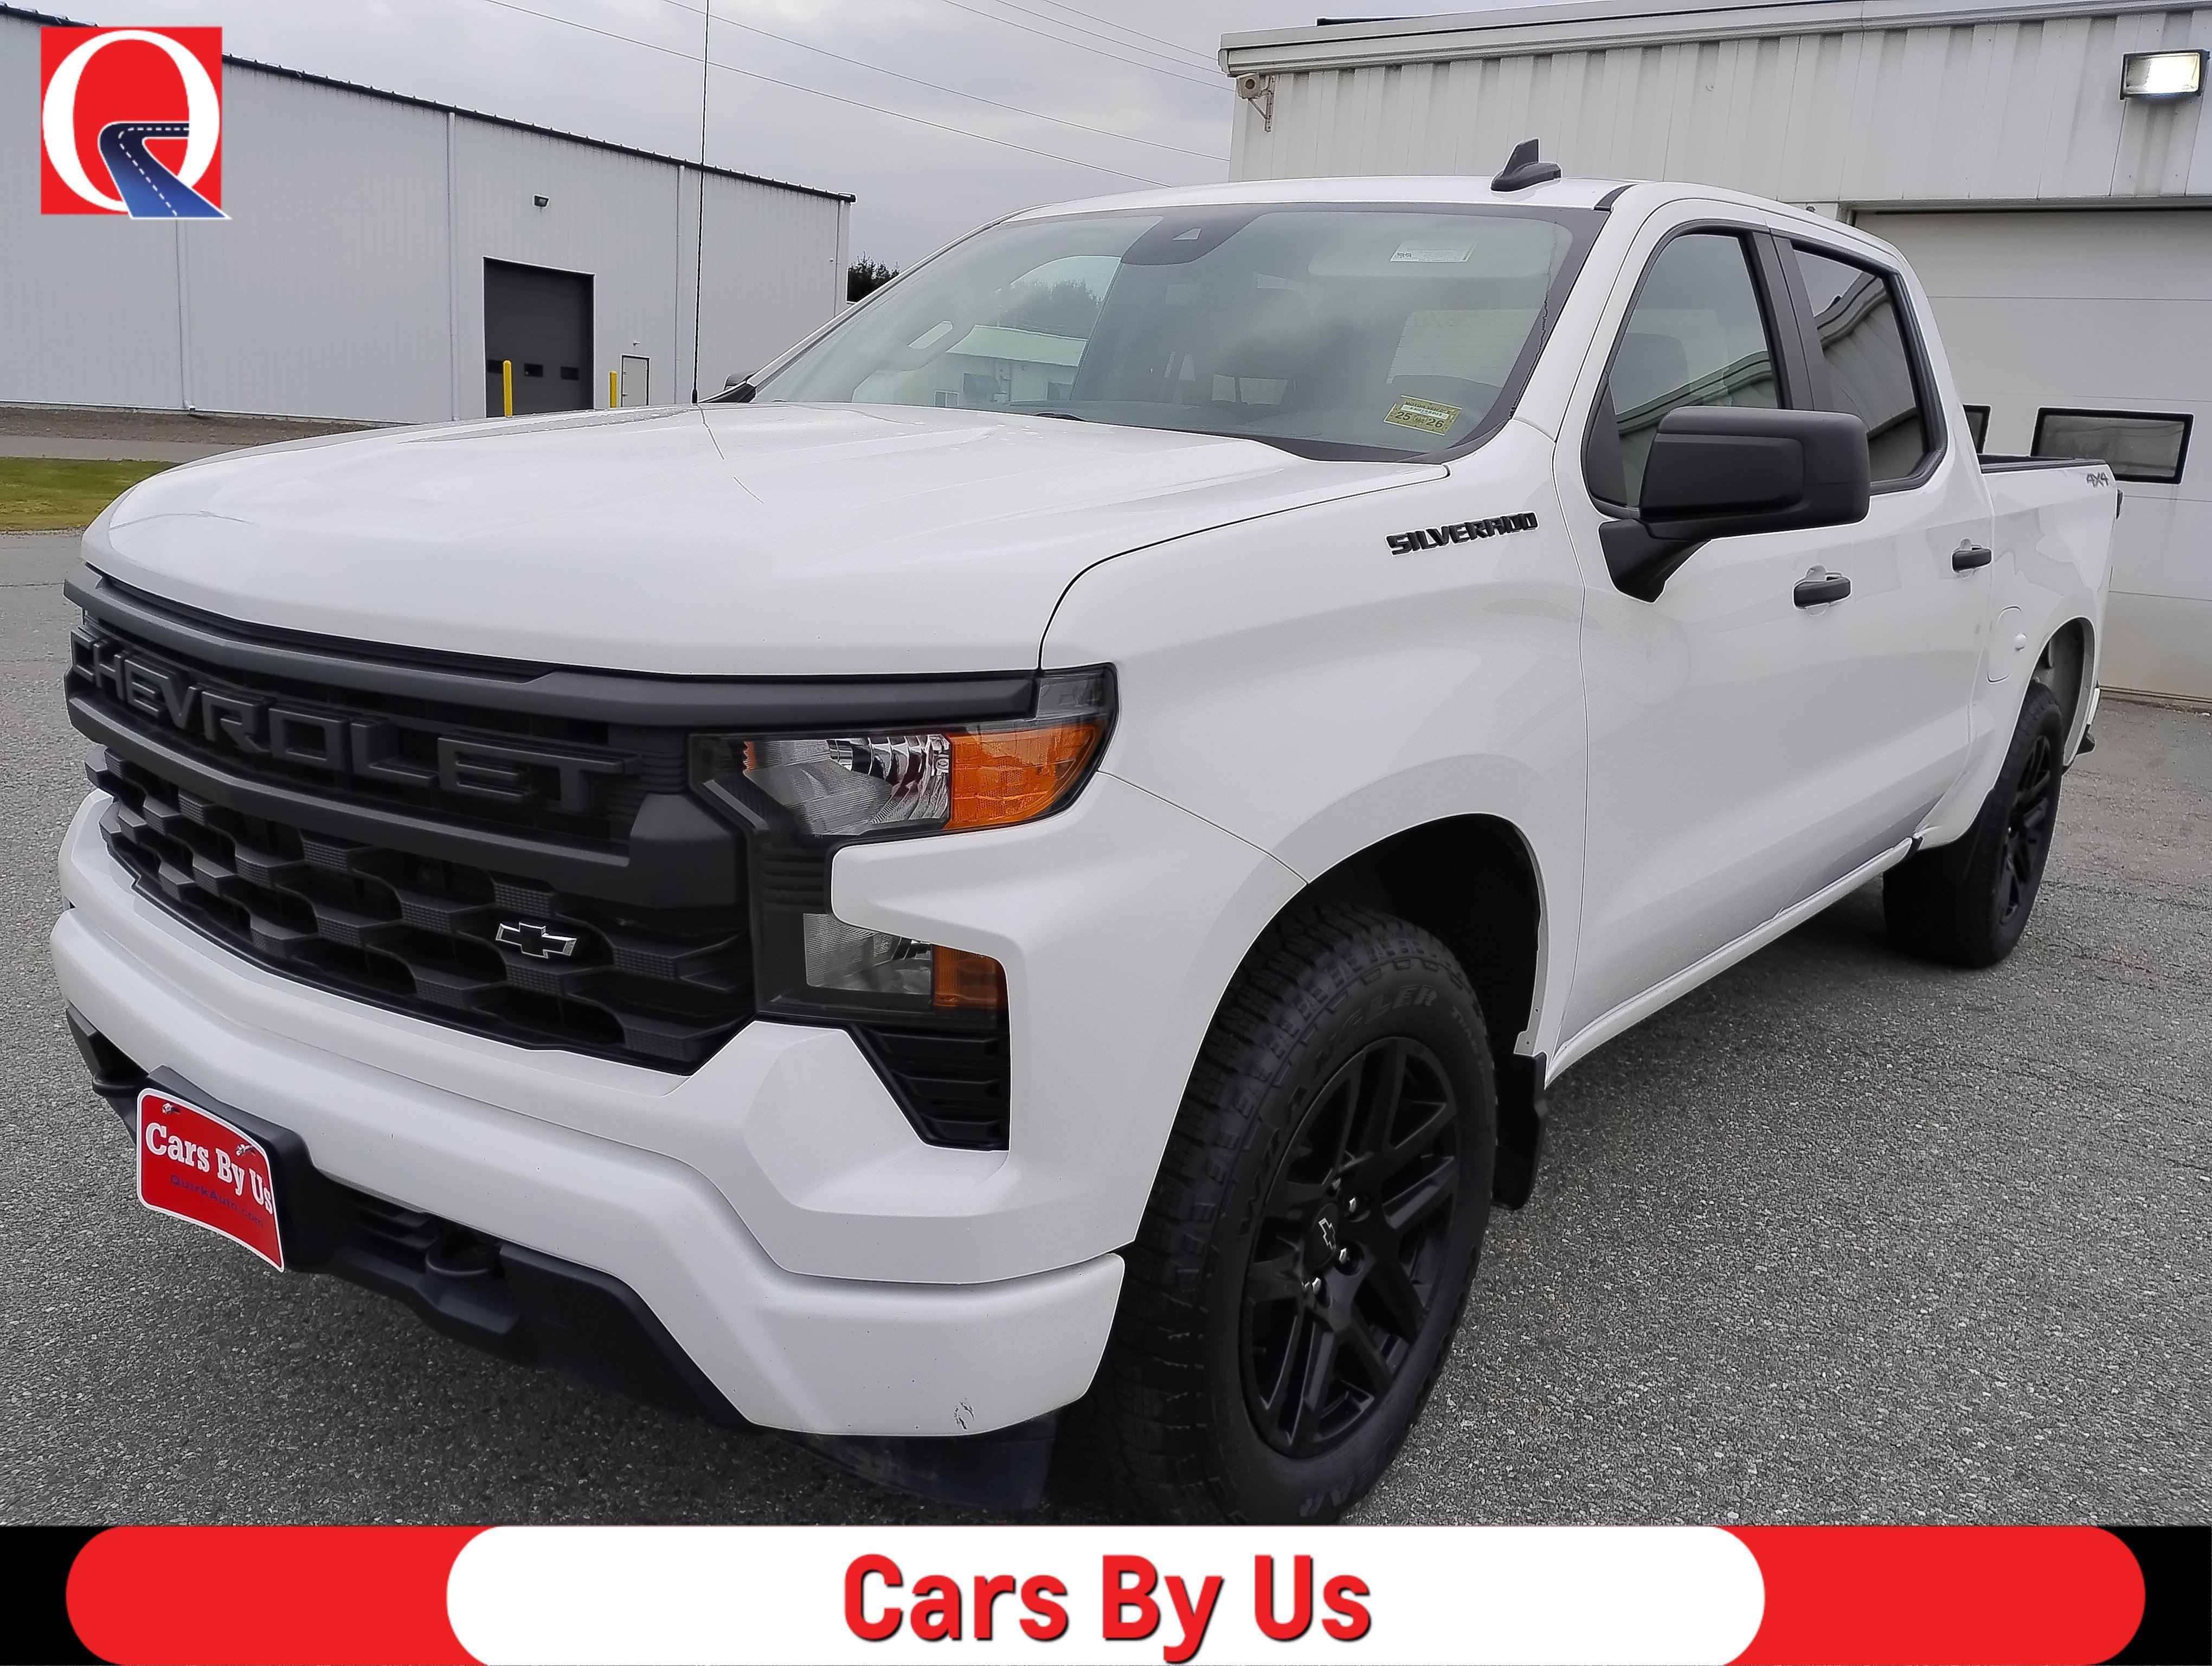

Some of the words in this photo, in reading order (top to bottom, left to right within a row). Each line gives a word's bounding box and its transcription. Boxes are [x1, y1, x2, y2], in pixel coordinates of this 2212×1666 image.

[1394, 411, 1413, 421] 25
[1425, 418, 1445, 428] 26
[1386, 512, 1538, 555] SILVERADO
[70, 629, 632, 812] CHEVROLET
[145, 1123, 210, 1173] Cars
[215, 1148, 245, 1196] By
[249, 1168, 273, 1215] Us
